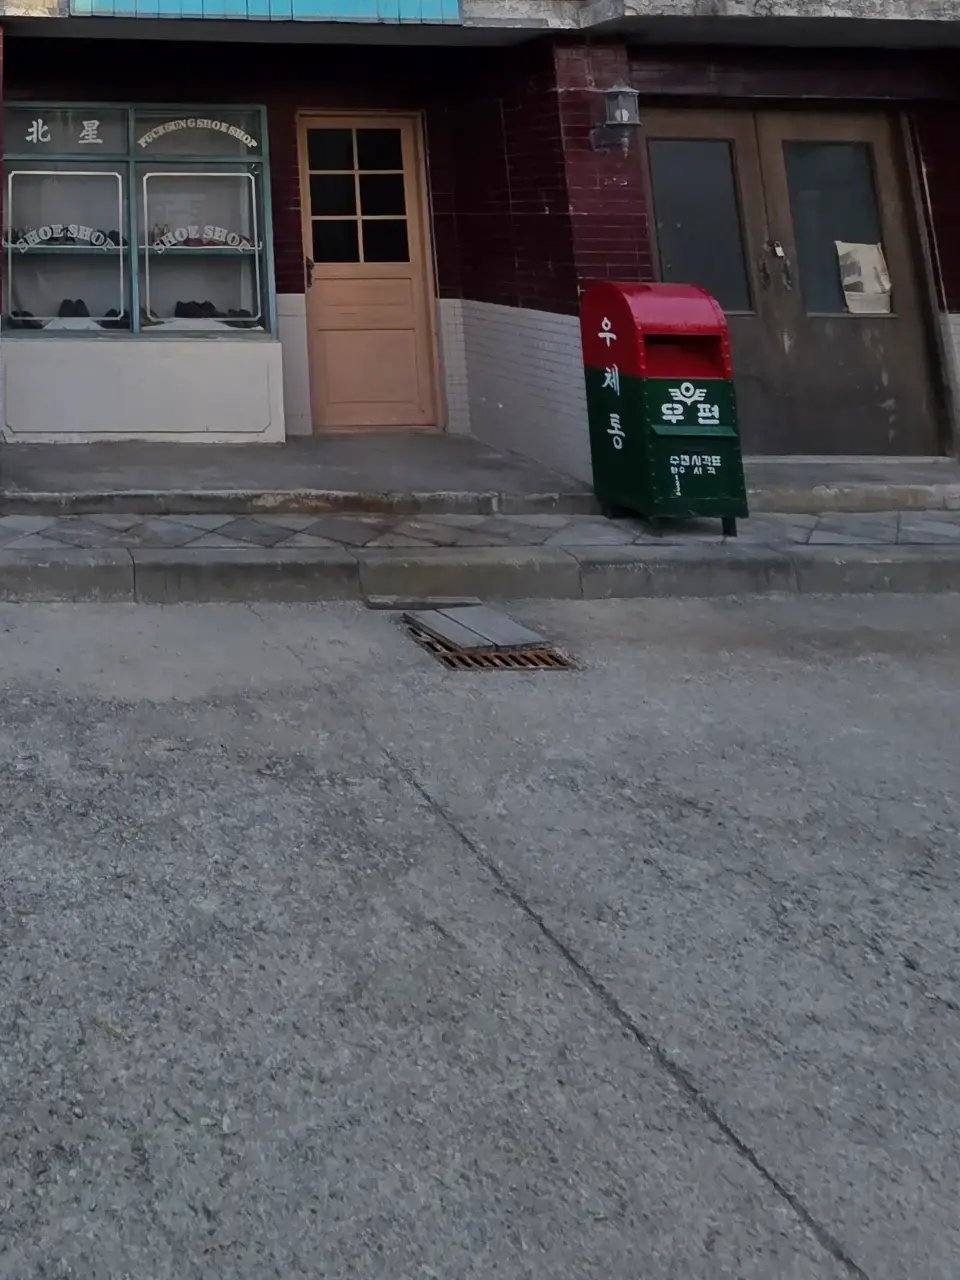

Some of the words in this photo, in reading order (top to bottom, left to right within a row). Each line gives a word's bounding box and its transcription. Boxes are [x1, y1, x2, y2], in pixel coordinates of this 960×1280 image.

[26, 118, 103, 144] 北星
[137, 118, 196, 148] PUCKSUNG
[197, 119, 229, 132] SHOE
[228, 126, 258, 148] SHOP
[16, 224, 64, 253] SHOE
[67, 224, 115, 252] SHOP
[153, 225, 200, 254] SHOE
[203, 225, 251, 252] SHOP
[661, 403, 720, 425] 우편
